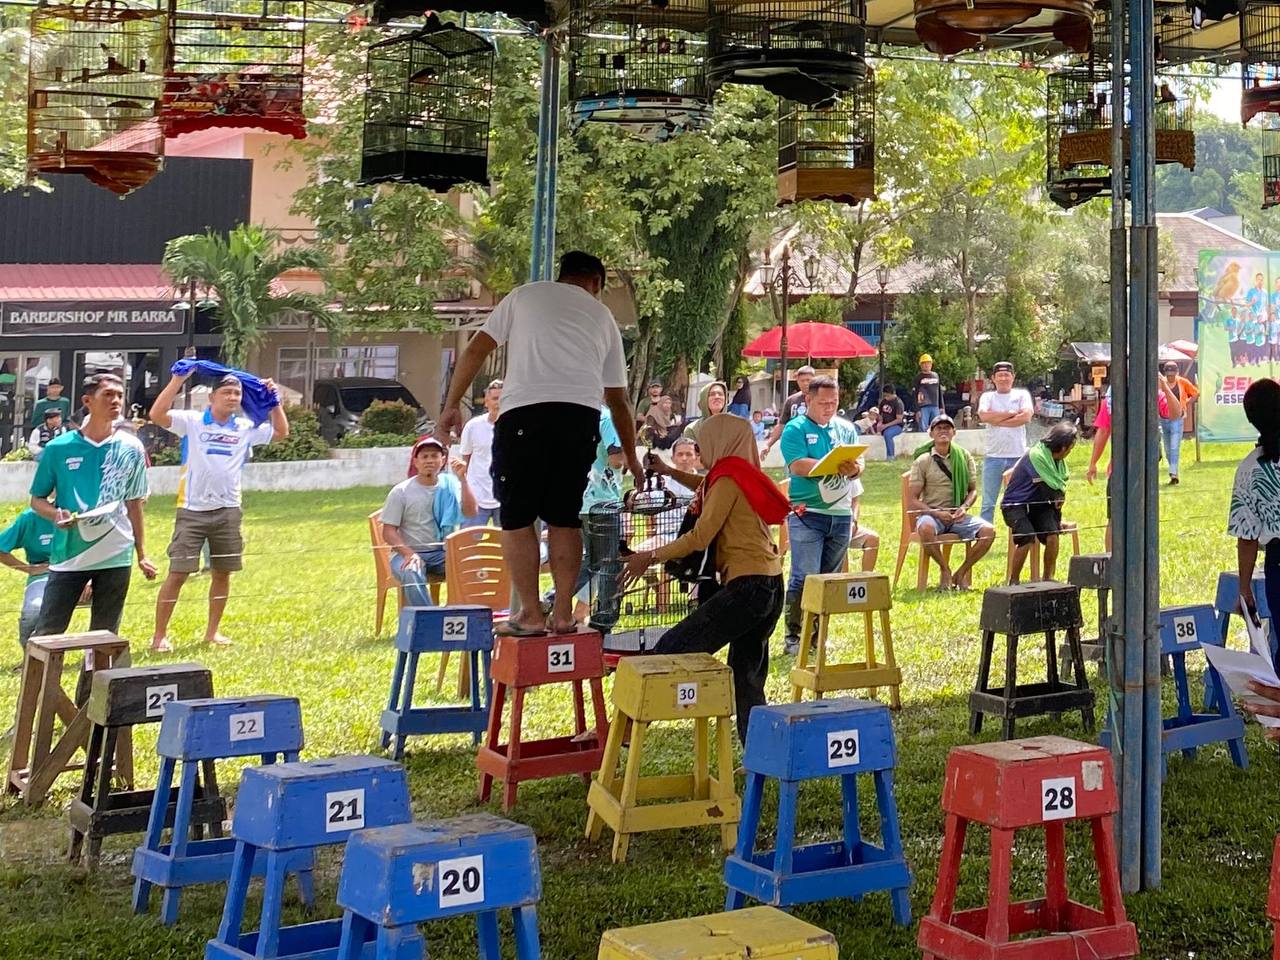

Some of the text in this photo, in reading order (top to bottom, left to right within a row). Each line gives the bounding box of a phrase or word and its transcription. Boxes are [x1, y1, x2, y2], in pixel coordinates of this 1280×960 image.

[10, 310, 175, 324] BARBERSHOP MR BARRA
[849, 586, 866, 598] 40
[445, 622, 466, 636] 32
[1177, 621, 1195, 638] 38
[550, 649, 573, 666] 31
[679, 688, 696, 701] 30
[236, 719, 258, 736] 22
[830, 737, 857, 760] 29
[1044, 786, 1075, 812] 28
[329, 797, 362, 824] 21
[442, 866, 481, 897] 20
